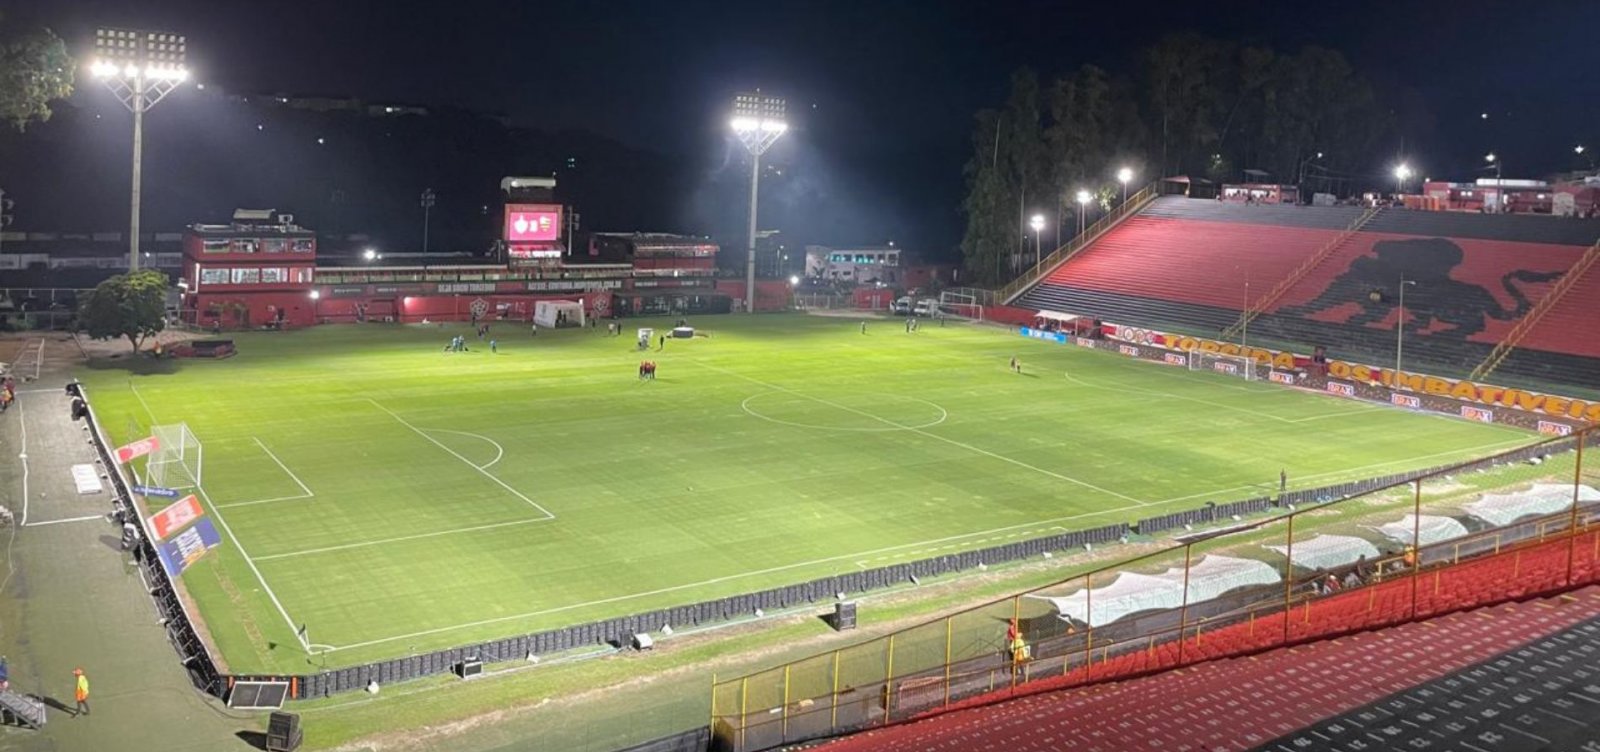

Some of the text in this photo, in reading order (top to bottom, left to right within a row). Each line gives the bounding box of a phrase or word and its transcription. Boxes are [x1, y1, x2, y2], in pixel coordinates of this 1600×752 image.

[1163, 334, 1295, 370] TORCIDA
[1328, 360, 1371, 383] OS
[1329, 383, 1352, 395] BRAX
[1394, 395, 1418, 407] BRAX
[1464, 408, 1490, 422] BRAX
[1541, 422, 1569, 436] BRAX
